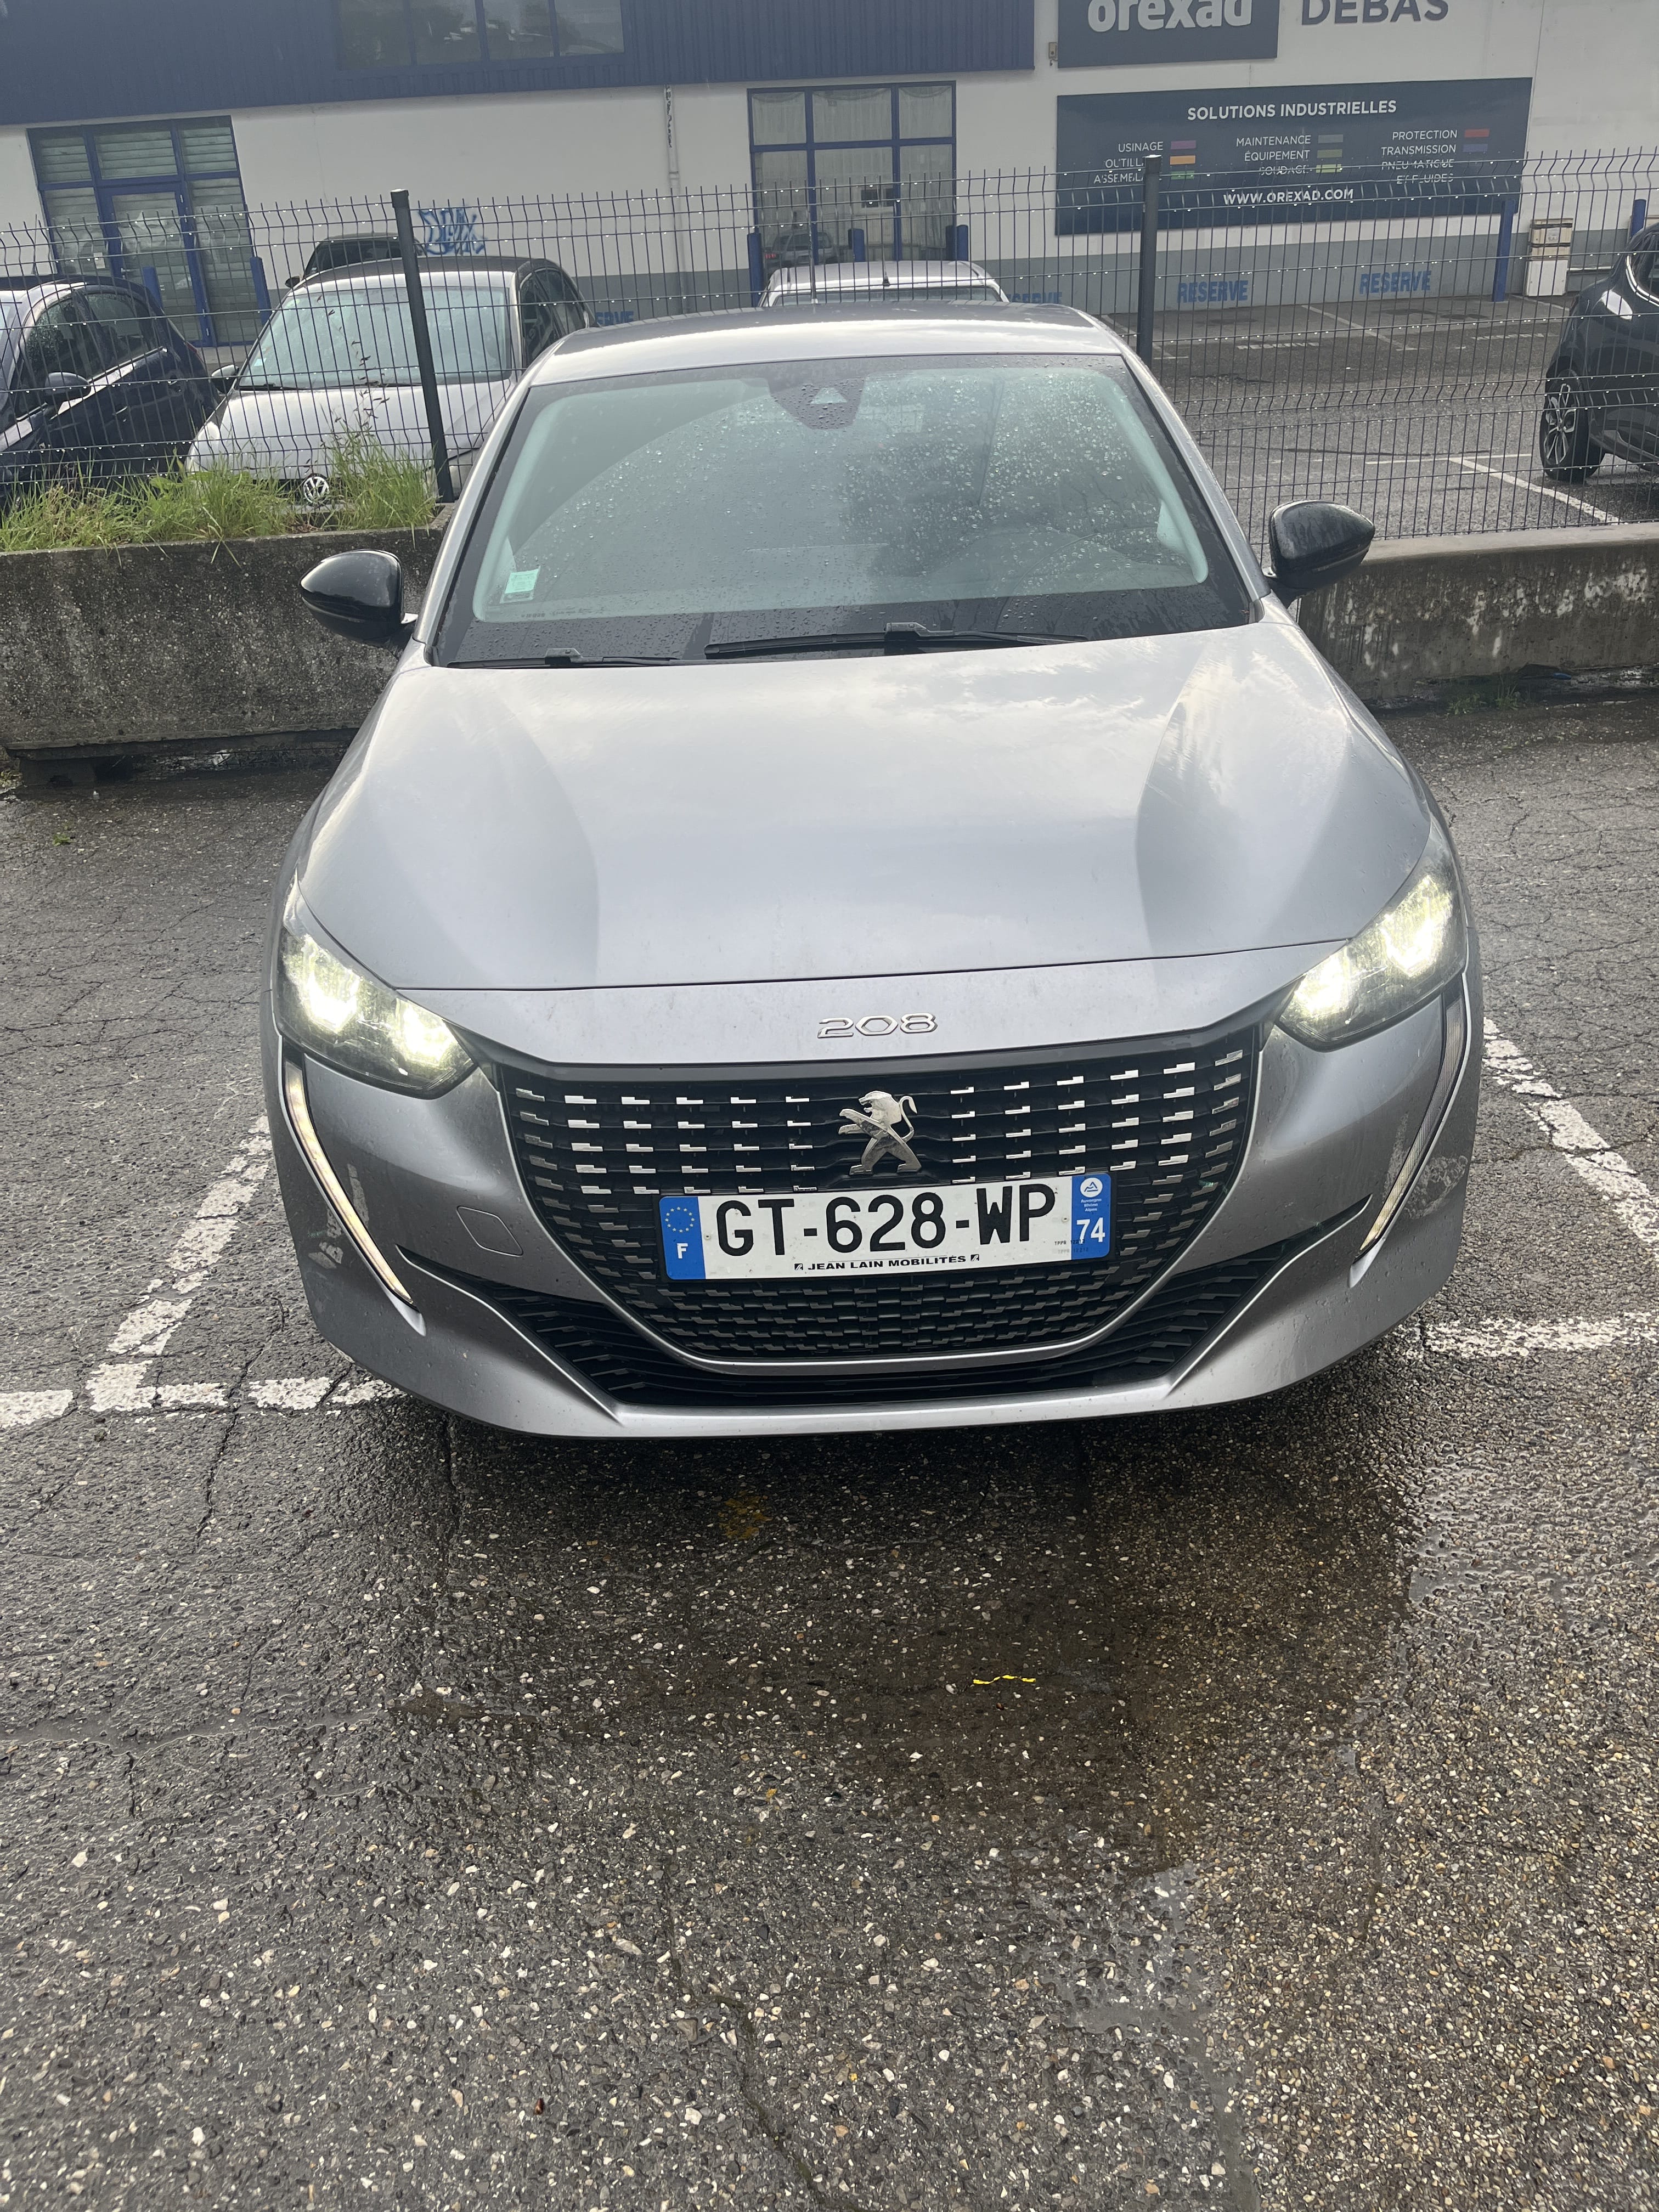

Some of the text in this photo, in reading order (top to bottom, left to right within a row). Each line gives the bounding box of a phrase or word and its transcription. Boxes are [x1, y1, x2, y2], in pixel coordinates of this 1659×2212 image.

[1302, 0, 1449, 25] DEBAS
[1187, 100, 1397, 121] SOLUTIONS INDUSTRIELLES
[1236, 135, 1311, 147] MAINTENANCE
[1392, 129, 1458, 140] PROTECTION
[1118, 141, 1164, 153] USINAGE
[1244, 149, 1311, 162] ÉQUIPEMENT
[1381, 144, 1457, 156] TRANSMISSION
[1222, 188, 1354, 205] WWW.OREXAD.COM
[1359, 270, 1432, 295] RESERVE
[1177, 280, 1249, 304] RESERVE
[817, 1012, 939, 1039] 208
[716, 1183, 1056, 1256] GT-628-WP
[1076, 1217, 1105, 1244] 74
[676, 1243, 689, 1259] F
[808, 1262, 845, 1271] JEAN
[850, 1260, 884, 1269] LAIN
